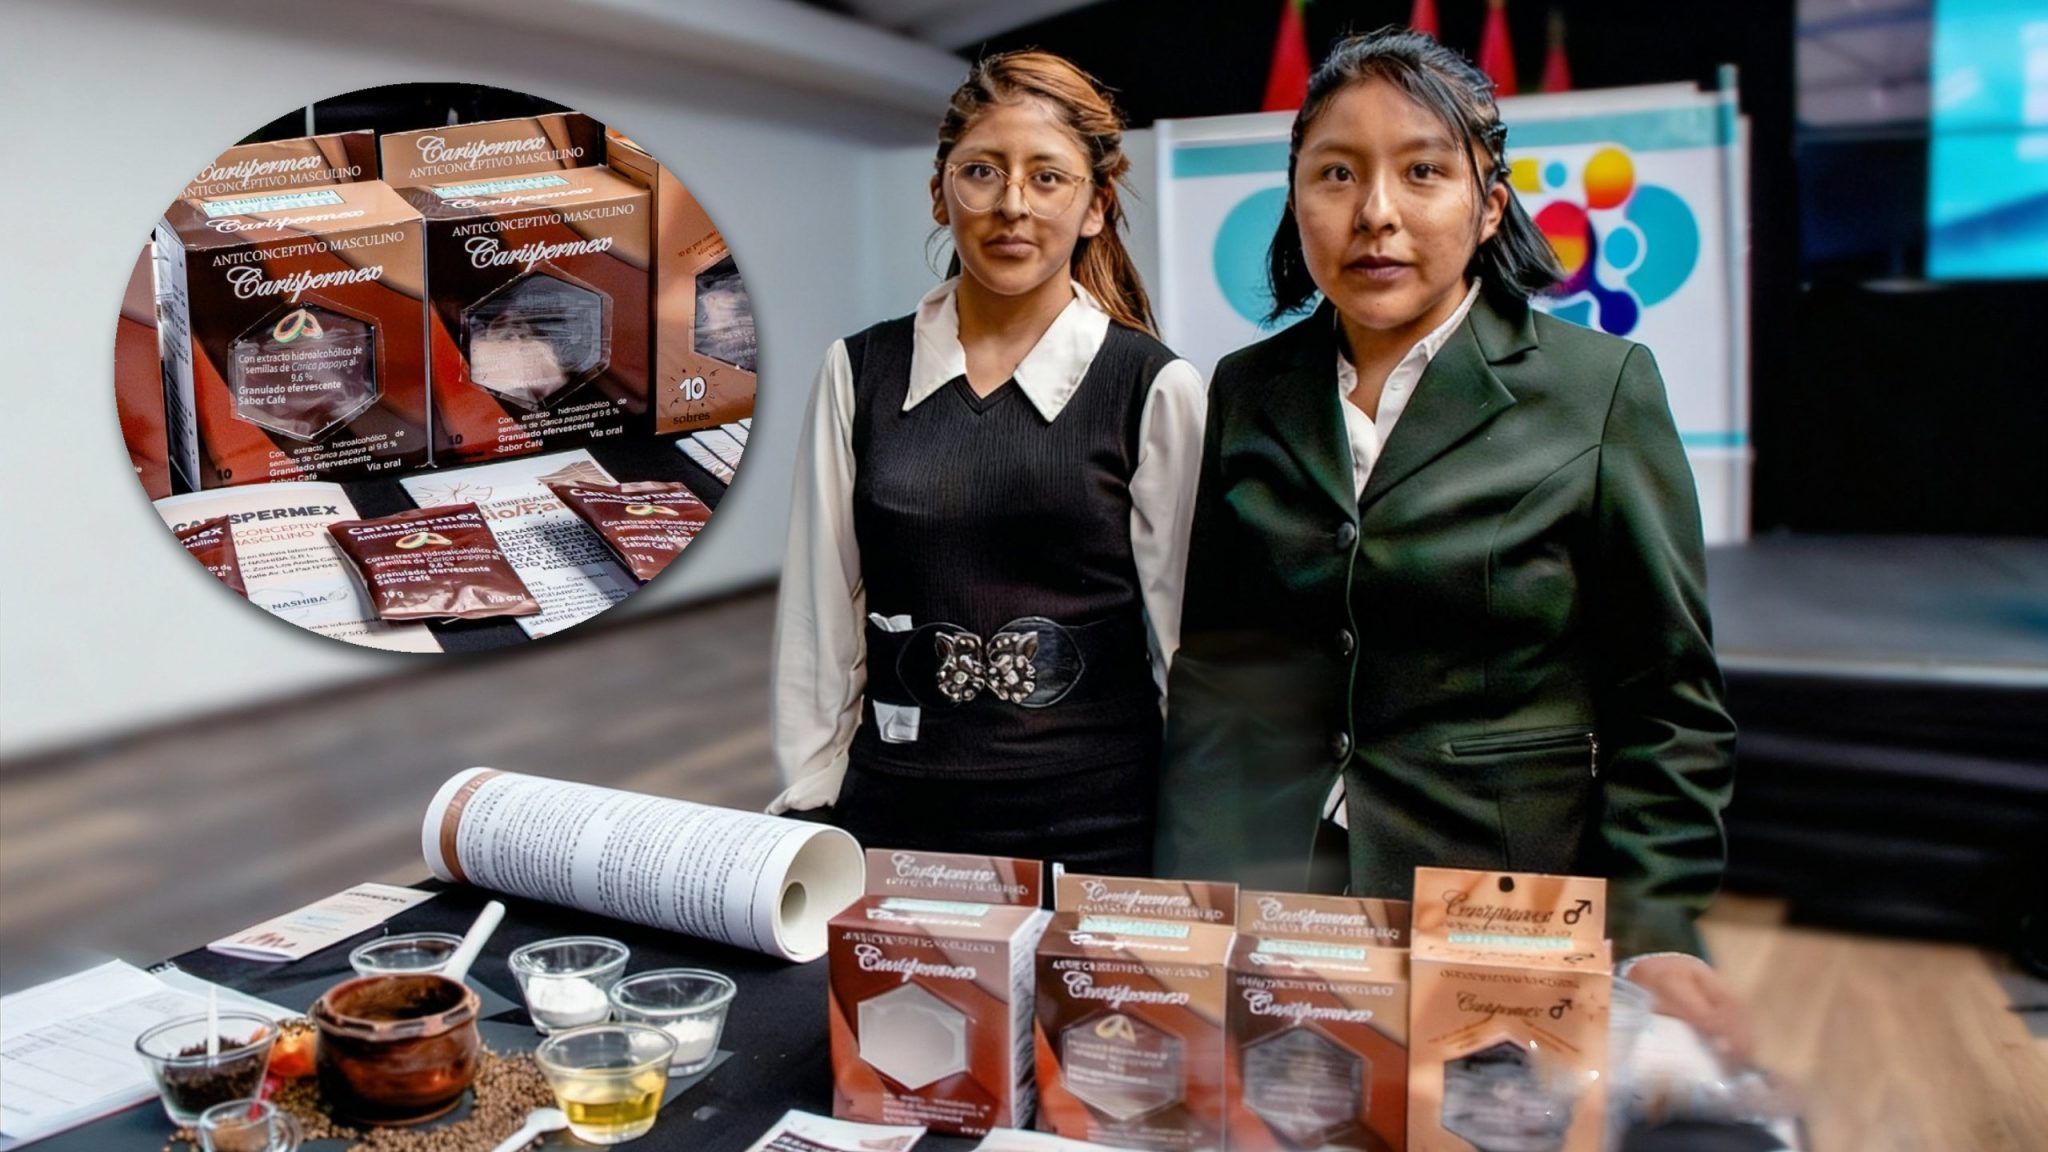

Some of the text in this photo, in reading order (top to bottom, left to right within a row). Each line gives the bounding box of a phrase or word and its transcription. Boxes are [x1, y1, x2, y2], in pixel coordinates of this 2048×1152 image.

[417, 135, 546, 168] Carispermex
[409, 146, 584, 179] ANTICONCEPTIVO MASCULINO
[181, 165, 362, 199] ANTICONCEPTIVO MASCULINO
[452, 203, 635, 237] ANTICONCEPTIVO MASCULINO
[212, 230, 404, 267] ANTICONCEPTIVO MASCULINO
[465, 235, 613, 272] Carispermex
[227, 264, 383, 303] Carispermex
[238, 345, 363, 364] Con extracto hidroalcohólico de
[246, 363, 278, 375] semillas
[279, 362, 291, 372] de
[317, 359, 348, 373] papaya
[291, 372, 313, 382] 9.6 %
[238, 381, 342, 396] Granulado efervescente
[680, 376, 707, 401] 10
[238, 393, 286, 406] Sabor Café
[498, 416, 514, 425] Con
[521, 411, 550, 421] extracto
[617, 397, 627, 405] de
[673, 411, 711, 425] sobres
[498, 421, 595, 443] Granulado efervescente
[528, 420, 539, 429] de
[605, 425, 623, 436] oral
[269, 450, 286, 459] Con
[293, 444, 324, 455] extracto
[395, 430, 405, 438] de
[301, 454, 312, 463] de
[388, 440, 397, 448] %
[497, 438, 544, 454] Sabor Café
[269, 454, 372, 477] Granulado efervescente
[383, 458, 401, 469] oral
[297, 472, 318, 482] Café
[172, 505, 340, 533] CASPERMEX
[348, 512, 482, 535] Carispermex
[496, 520, 573, 537] DESARROLLO
[233, 522, 331, 538] CONCEPTIVO
[356, 521, 482, 542] Anticonceptivo masculino
[622, 541, 651, 549] Sabor
[364, 556, 383, 565] Con
[384, 552, 422, 562] extracto
[422, 546, 491, 558] hidroalcohólico
[375, 558, 412, 568] semillas
[412, 556, 425, 565] de
[374, 565, 491, 581] Granulado efervescente
[376, 574, 431, 587] Sabor Café
[271, 595, 328, 610] NASHIBA
